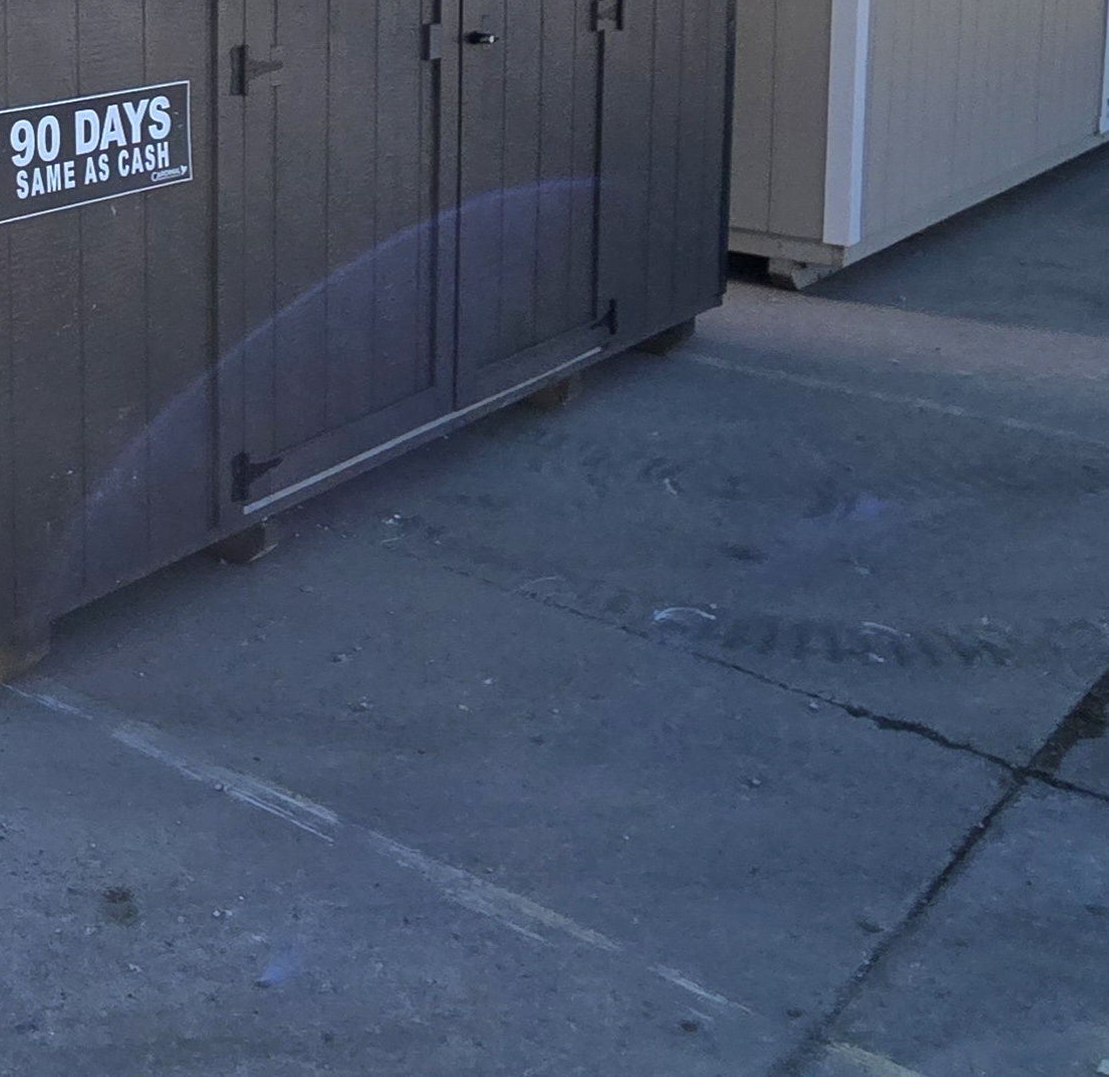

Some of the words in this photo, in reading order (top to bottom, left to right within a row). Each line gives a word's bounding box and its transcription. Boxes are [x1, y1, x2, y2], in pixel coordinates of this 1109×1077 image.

[10, 115, 61, 167] 90
[75, 95, 171, 155] DAYS
[16, 160, 76, 199] SAME
[84, 153, 110, 185] AS
[118, 141, 170, 177] CASH
